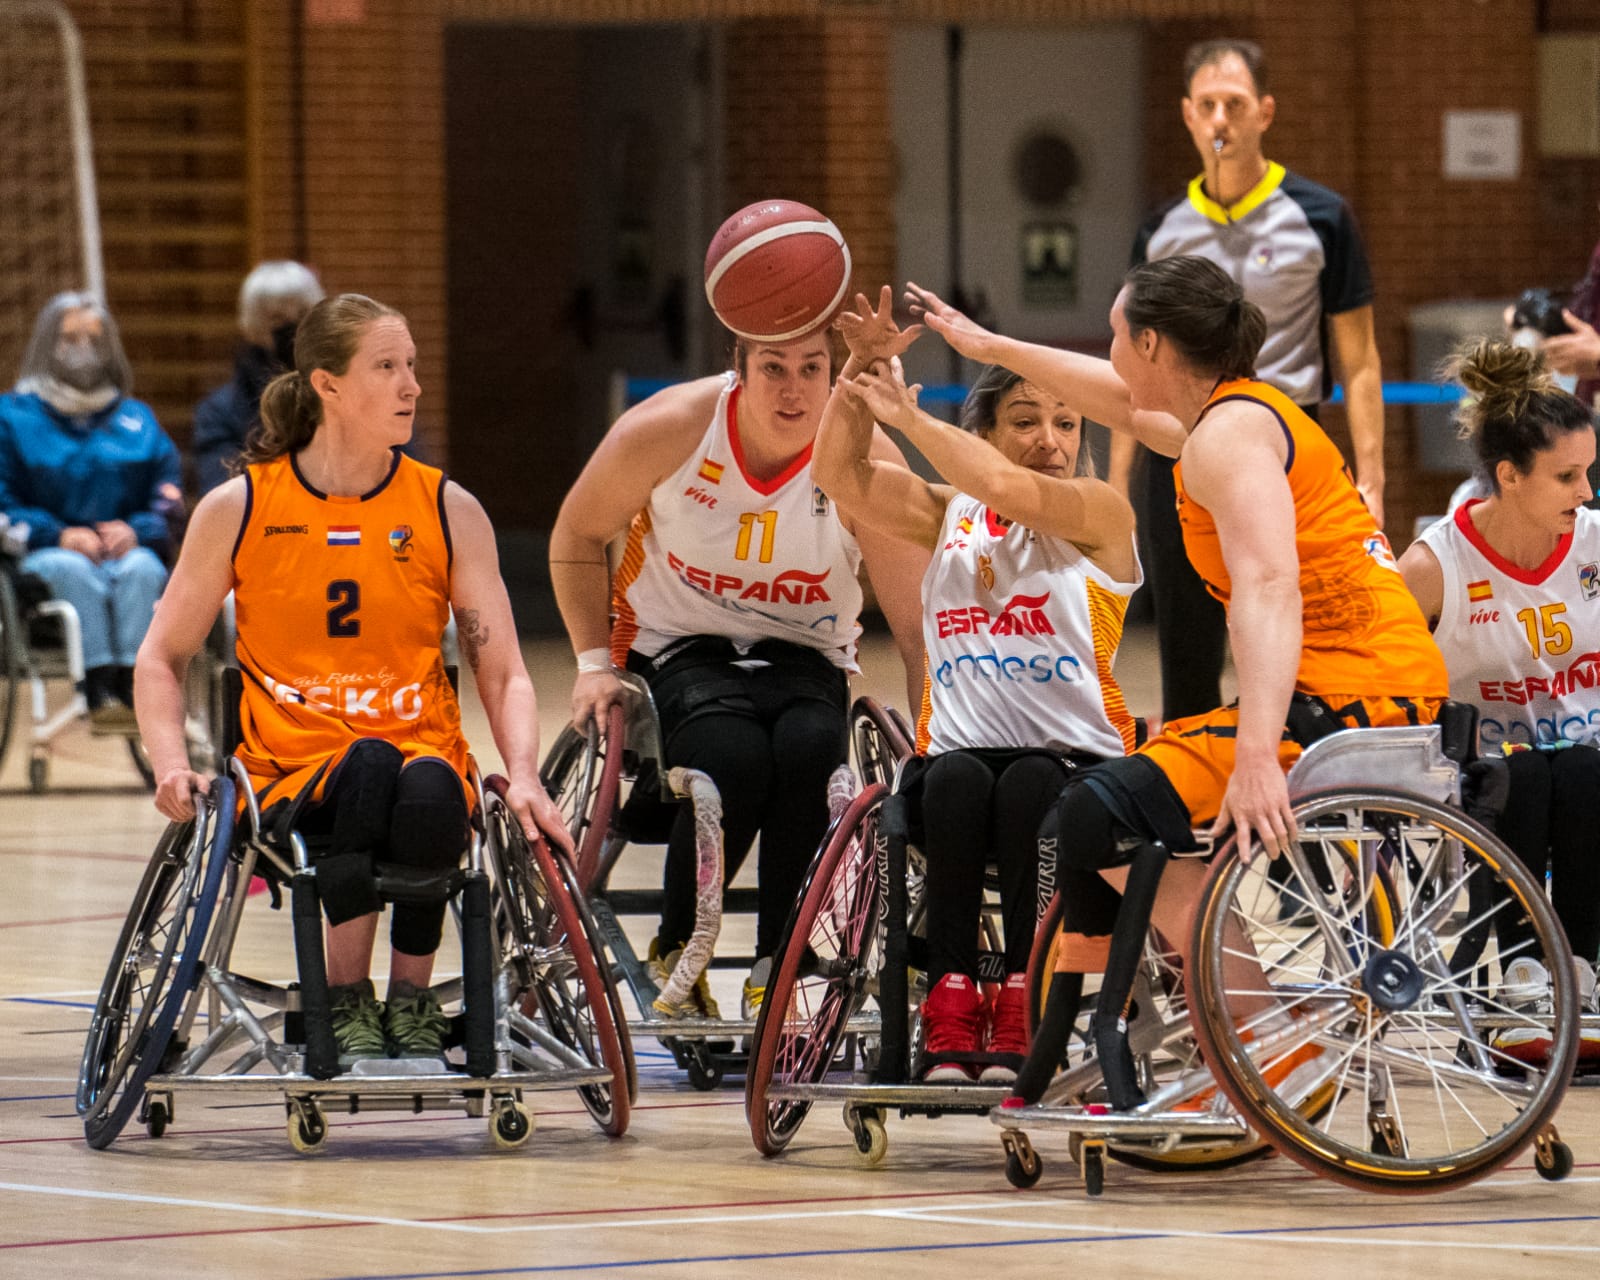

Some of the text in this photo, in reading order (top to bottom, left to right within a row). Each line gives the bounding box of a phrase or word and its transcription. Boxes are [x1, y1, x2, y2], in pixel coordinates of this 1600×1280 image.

[734, 510, 778, 564] 11
[326, 578, 361, 638] 2
[1517, 602, 1573, 660] 15
[1478, 651, 1600, 706] ESPAÑ
